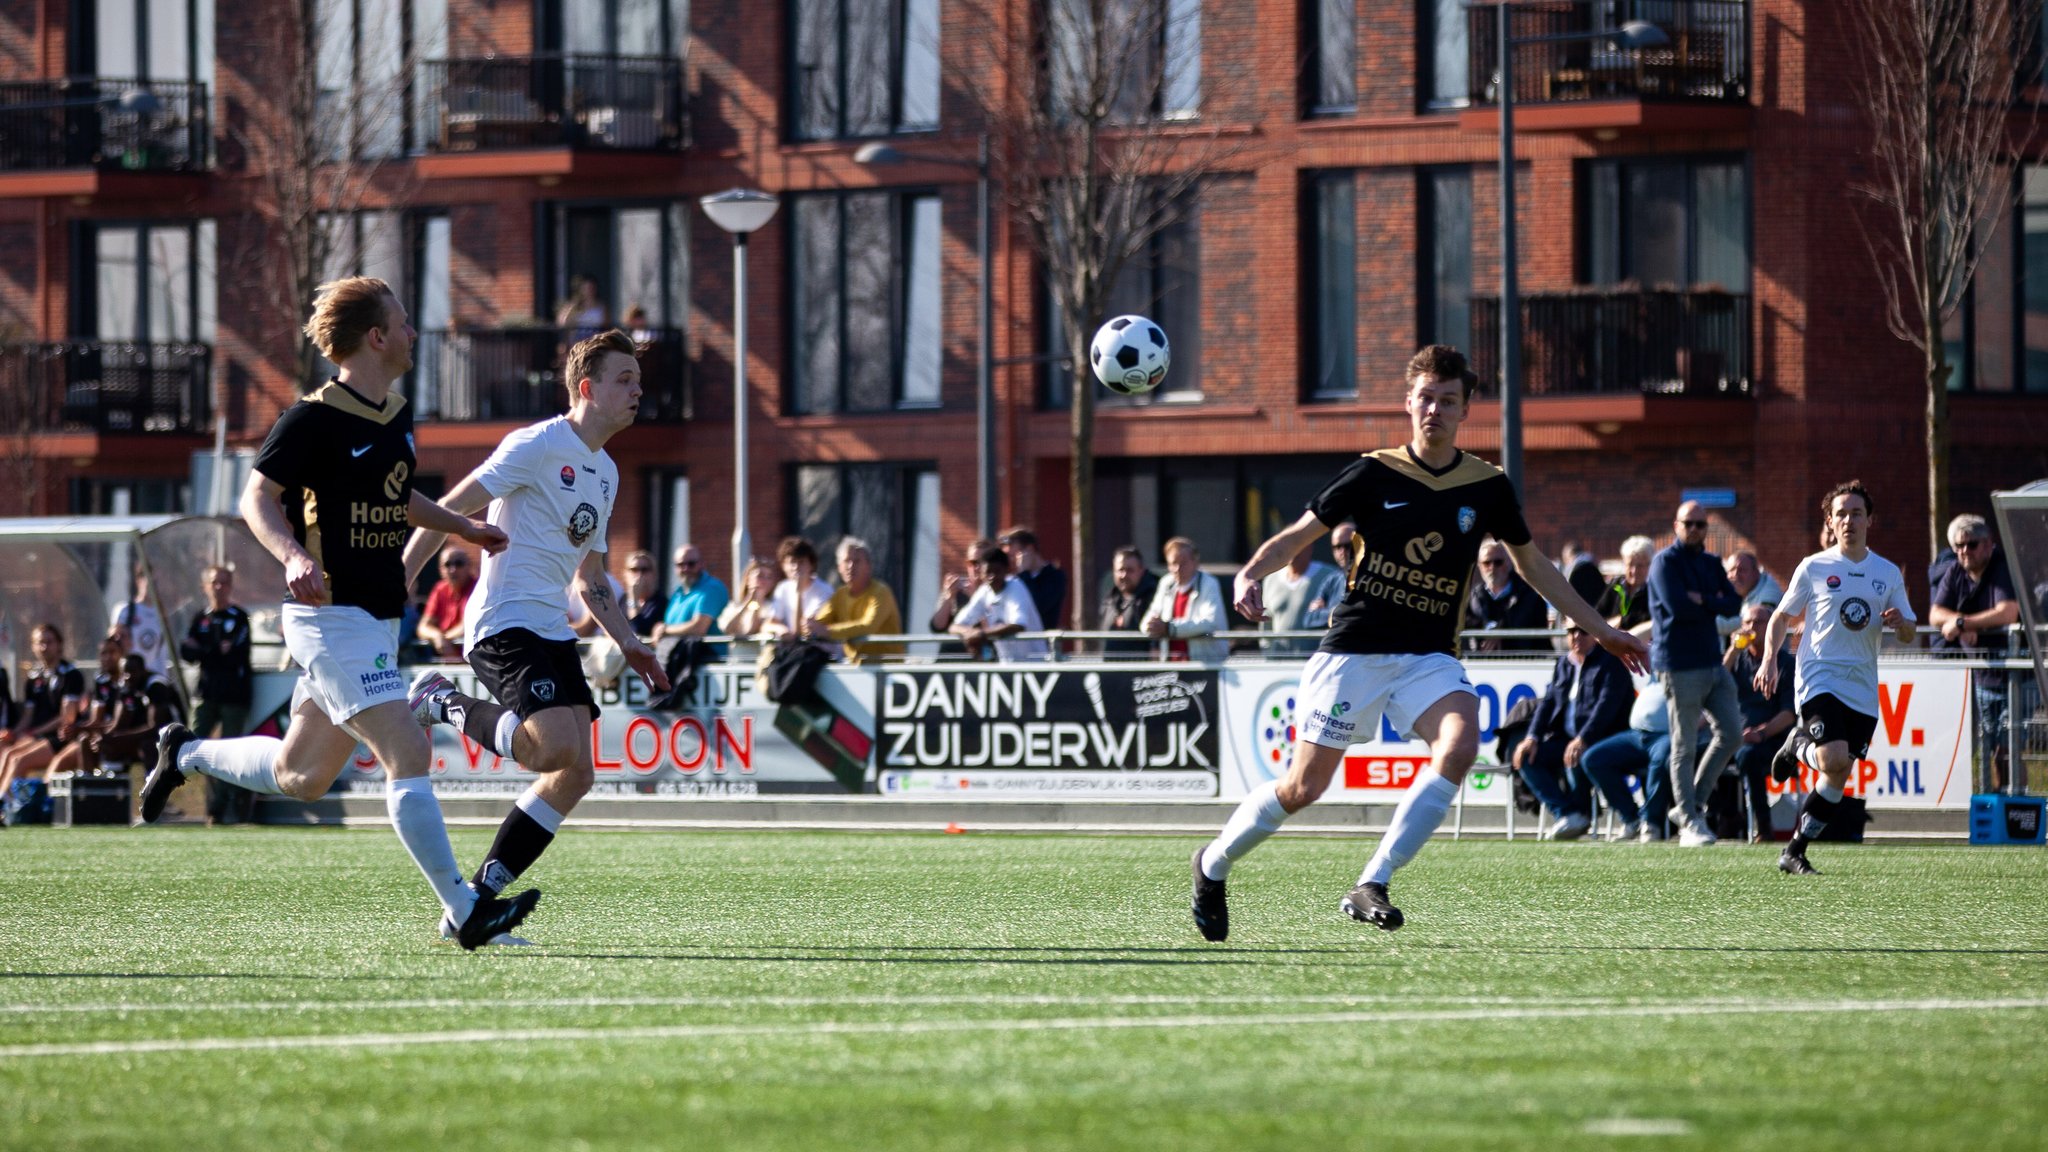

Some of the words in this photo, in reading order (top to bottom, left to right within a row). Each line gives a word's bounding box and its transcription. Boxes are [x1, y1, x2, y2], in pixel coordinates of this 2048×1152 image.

[1356, 574, 1450, 616] Horecavo
[1367, 551, 1459, 596] Horesca
[884, 672, 1060, 718] DANNY
[591, 714, 756, 771] LOON
[1312, 709, 1356, 731] Horesca
[883, 722, 1210, 768] ZUIJDERWIJK
